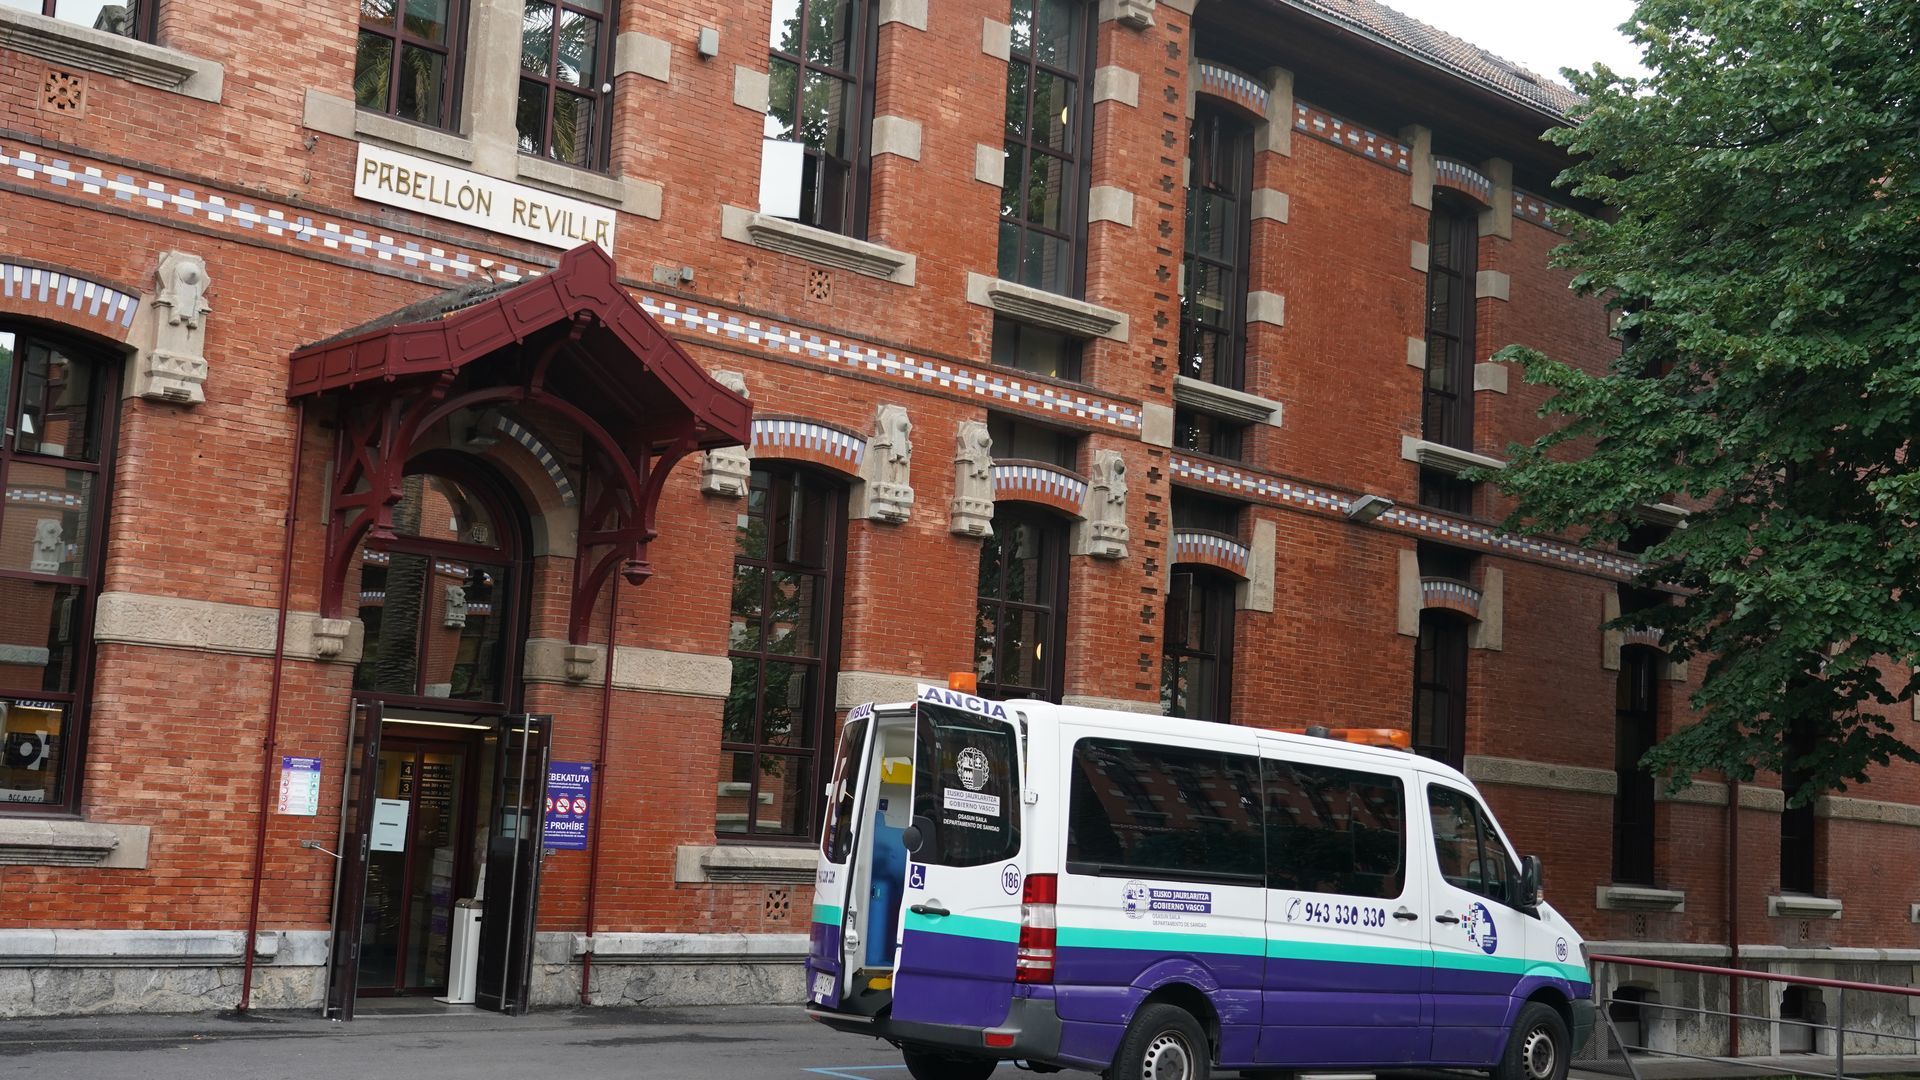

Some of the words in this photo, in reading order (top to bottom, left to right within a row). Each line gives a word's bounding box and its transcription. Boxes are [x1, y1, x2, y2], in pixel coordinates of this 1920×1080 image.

[362, 158, 493, 217] PABELLÓN
[512, 197, 610, 247] REVILLA
[946, 789, 965, 798] EUSKO
[965, 792, 997, 803] JAURLARITZA
[949, 800, 978, 810] GOBIERNO
[978, 804, 996, 812] VASCO
[957, 813, 975, 821] OSASUN
[550, 820, 585, 831] PROHÍBE
[943, 818, 977, 829] DEPARTAMENTO
[982, 824, 1000, 832] SANIDAD
[1004, 871, 1019, 888] 186
[1153, 890, 1172, 898] EUSKO
[1172, 891, 1209, 901] JAURLARITZA
[1152, 901, 1184, 910] GOBIERNO
[1185, 903, 1205, 912] VASCO
[1305, 901, 1330, 923] 943
[1335, 904, 1358, 925] 330
[1363, 906, 1386, 927] 330
[1557, 943, 1566, 956] 186
